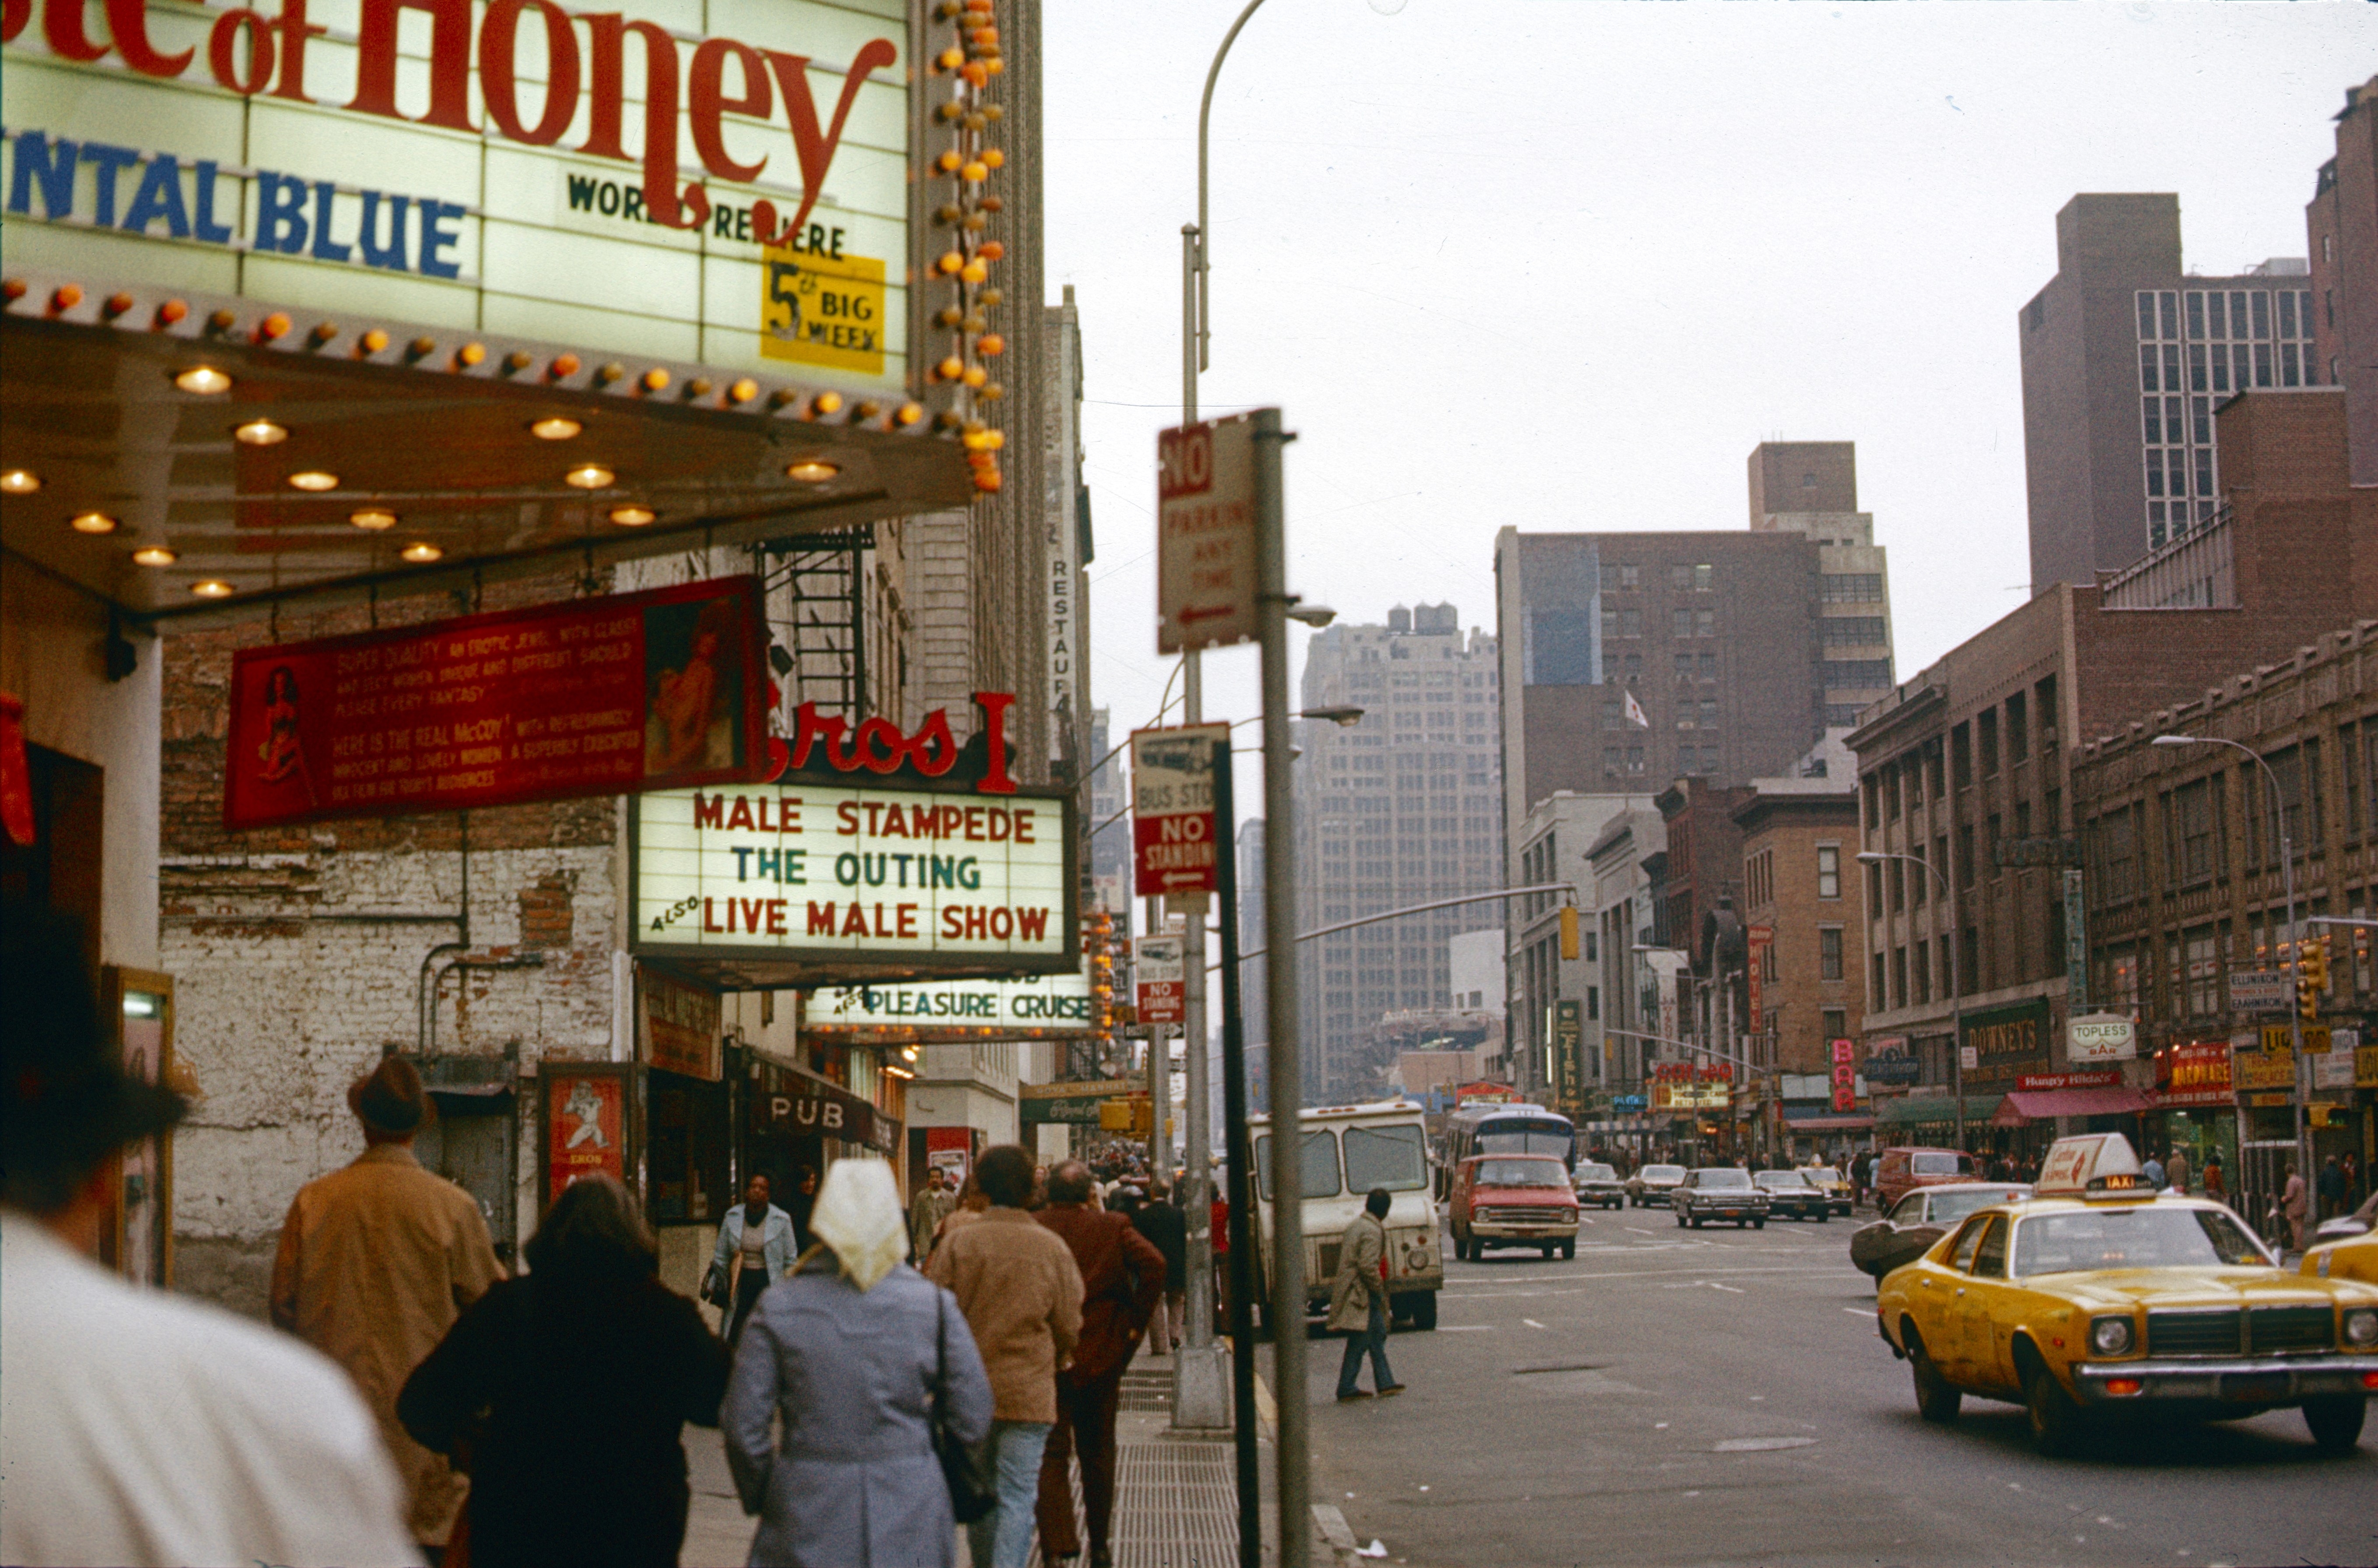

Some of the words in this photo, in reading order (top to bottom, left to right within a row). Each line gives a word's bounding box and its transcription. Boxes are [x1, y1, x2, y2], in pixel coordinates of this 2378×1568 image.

[336, 0, 897, 246] Honey
[0, 126, 232, 242] NTAL
[255, 170, 466, 279] BLUE
[568, 174, 690, 227] WOR
[821, 292, 872, 321] BIG
[808, 321, 877, 352] WEEK
[1161, 433, 1210, 493] NO
[370, 732, 383, 753] IS
[388, 728, 410, 753] THE
[416, 722, 448, 750] REAL
[767, 680, 958, 783] ros
[1181, 783, 1213, 807] STO
[694, 793, 803, 834] MALE
[836, 800, 1036, 845] STAMPEDE
[1161, 816, 1205, 842] NO
[731, 847, 807, 885] THE
[835, 853, 980, 891] OUTING
[1145, 842, 1213, 872] STANDIN
[650, 896, 698, 932] ALSO
[704, 897, 789, 935] LIVE
[807, 901, 919, 940] MALE
[942, 905, 1048, 942] SHOW
[1150, 983, 1172, 996] NO
[867, 991, 997, 1018] PLEASURE
[1011, 994, 1091, 1020] CRUISE
[2075, 1022, 2127, 1037] TOPLESS
[2089, 1044, 2117, 1056] BAR
[1832, 1038, 1855, 1112] BAR
[2025, 1076, 2065, 1087] Hungry
[772, 1096, 844, 1129] PUB
[571, 1154, 602, 1165] EROS
[2105, 1175, 2135, 1189] TAXI
